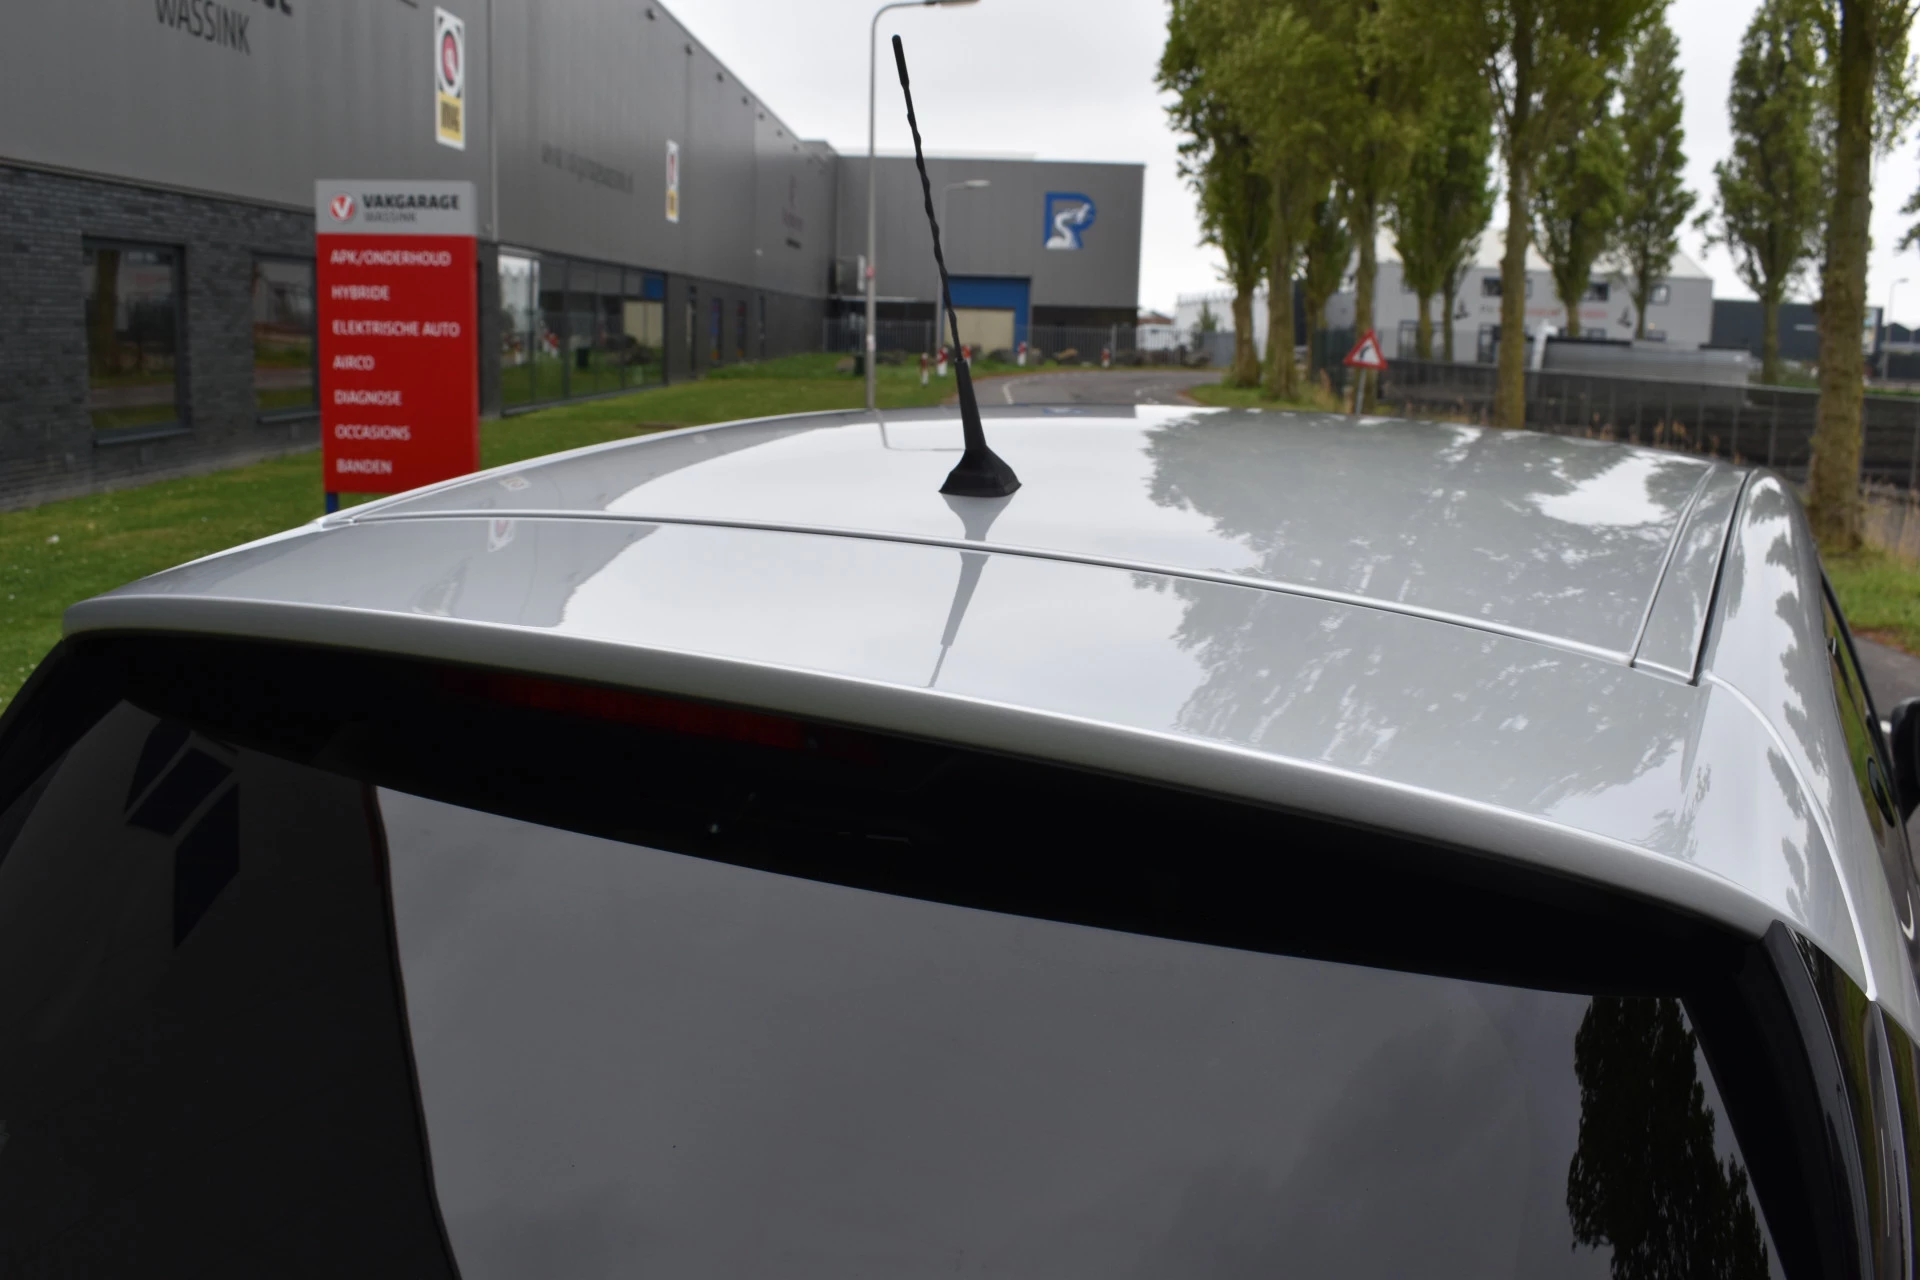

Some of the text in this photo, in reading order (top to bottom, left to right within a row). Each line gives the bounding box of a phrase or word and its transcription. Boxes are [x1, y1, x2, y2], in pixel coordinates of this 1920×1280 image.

[155, 0, 251, 56] WASSINK
[362, 194, 460, 210] VAKGARAGE
[330, 250, 452, 267] APK/ONDERHOUD
[331, 285, 390, 301] HYBRIDE
[332, 320, 461, 338] ELEKTRISCHE AUTO
[332, 355, 375, 371] AIRCO
[334, 389, 403, 406] DIAGNOSE
[335, 424, 411, 441] OCCASIONS
[336, 459, 393, 475] BANDEN
